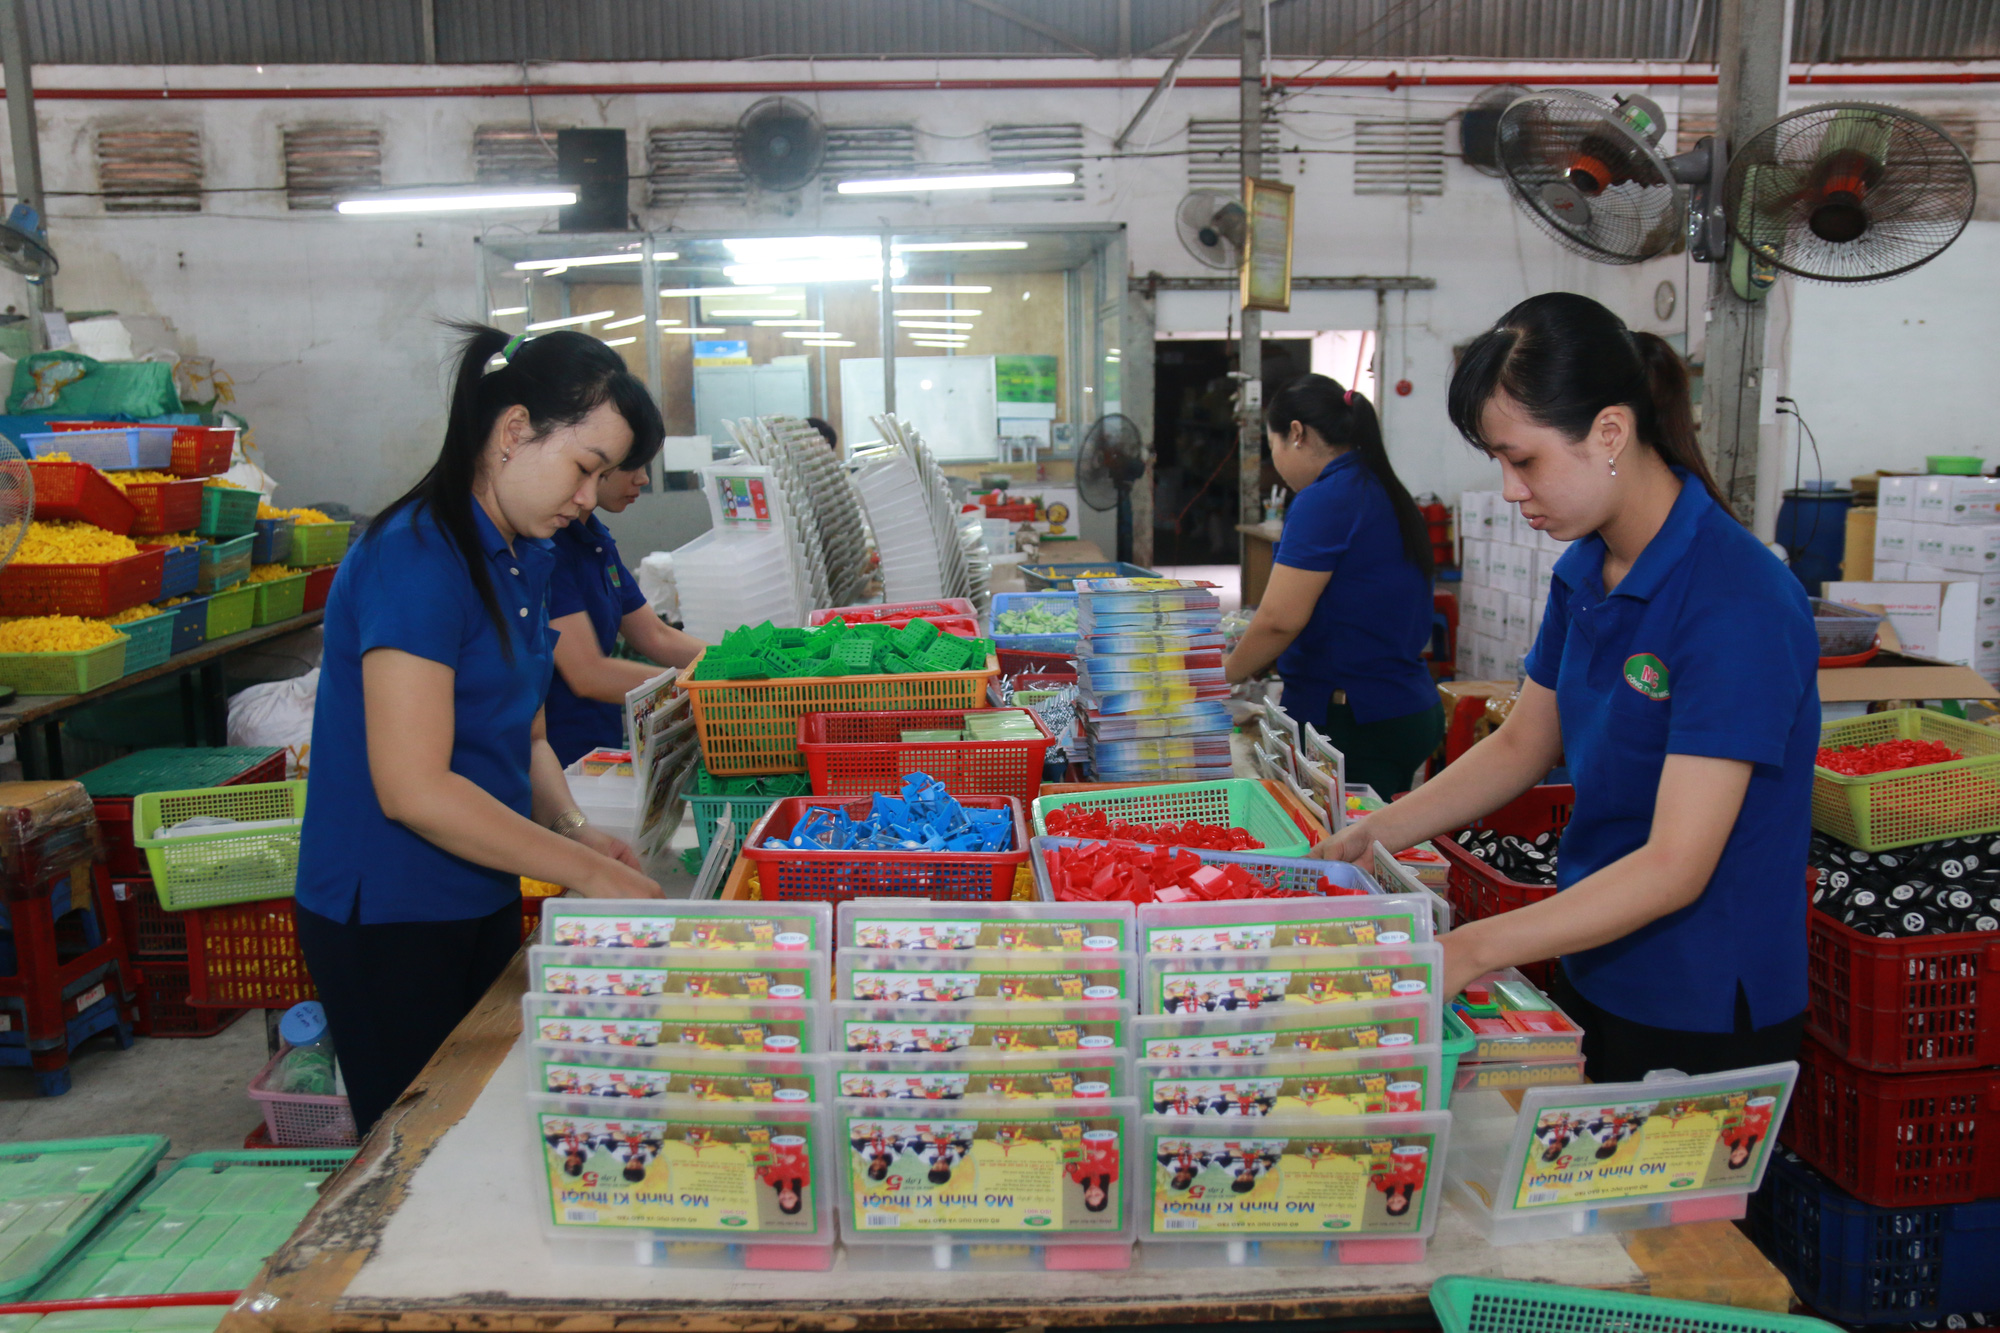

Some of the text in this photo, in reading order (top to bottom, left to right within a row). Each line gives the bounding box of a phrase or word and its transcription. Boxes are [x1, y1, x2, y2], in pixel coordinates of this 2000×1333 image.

[1554, 1155, 1573, 1170] 5
[1639, 1162, 1666, 1175] Mô
[1599, 1165, 1634, 1178] hình
[582, 1171, 599, 1187] 5
[886, 1174, 904, 1191] 5
[1529, 1172, 1573, 1188] thuật
[561, 1189, 608, 1205] thuật
[636, 1192, 674, 1206] hình
[1188, 1185, 1206, 1199] 5
[680, 1193, 709, 1208] Mô
[863, 1192, 910, 1208] thuật
[939, 1194, 978, 1208] hình
[985, 1194, 1014, 1208] Mô
[1163, 1200, 1211, 1213] thuật
[1240, 1202, 1278, 1214] hình
[1285, 1202, 1315, 1213] Mô
